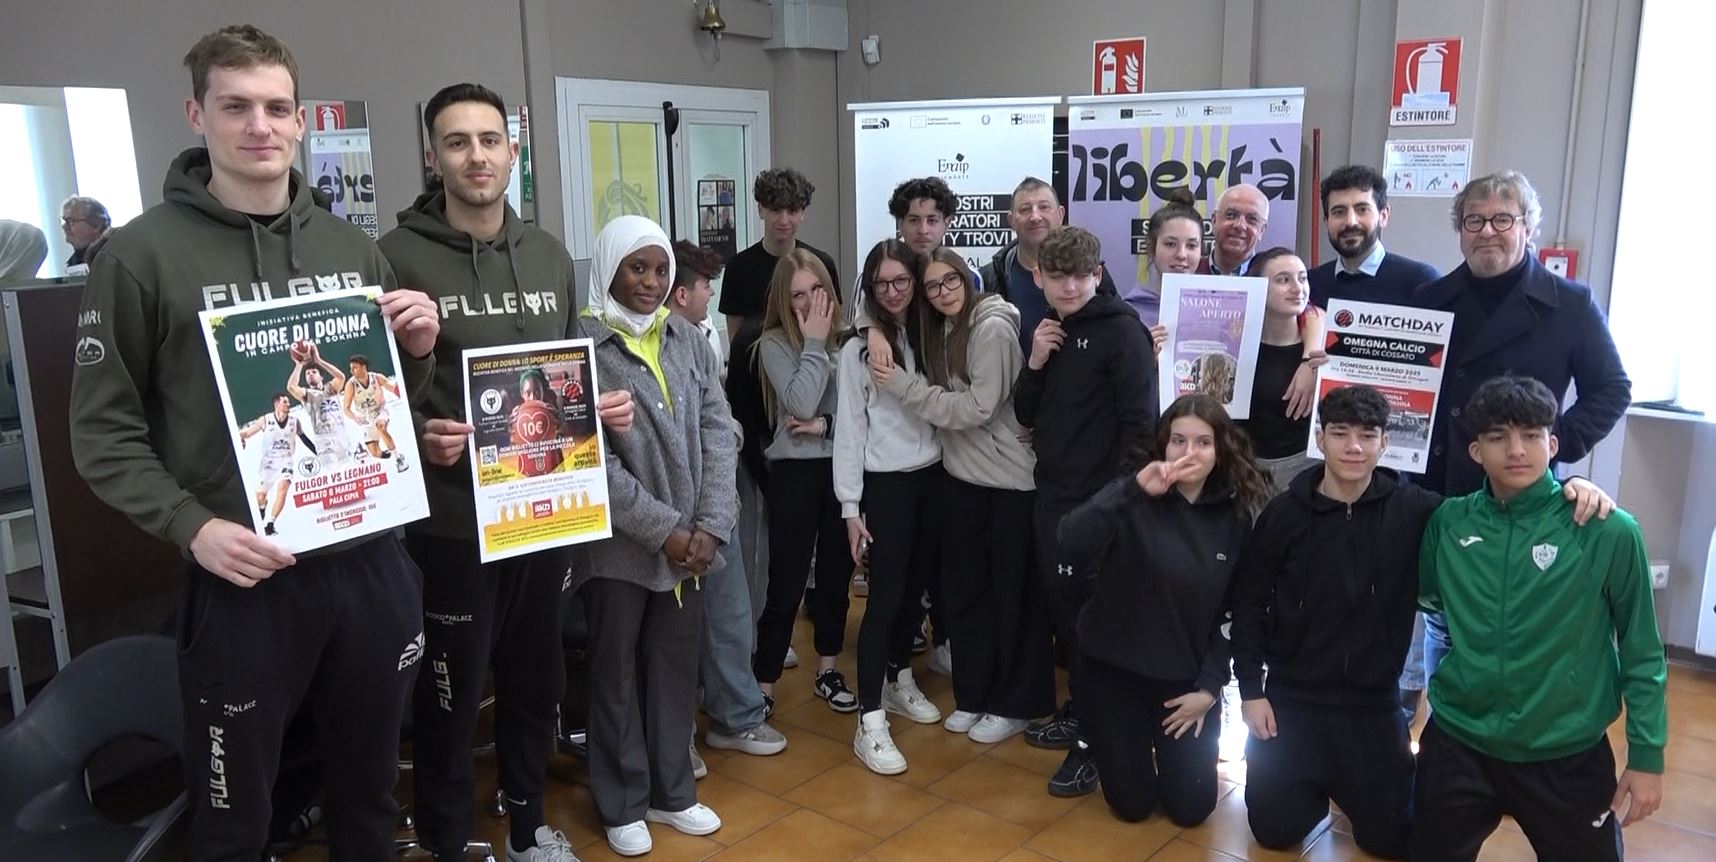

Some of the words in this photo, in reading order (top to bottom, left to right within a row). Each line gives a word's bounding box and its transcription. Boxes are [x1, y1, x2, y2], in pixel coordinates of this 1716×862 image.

[1395, 110, 1450, 122] ESTINTORE
[1072, 138, 1296, 202] libertà
[956, 196, 994, 210] STRI
[948, 214, 1000, 228] RATORI
[964, 232, 1008, 245] TROVI
[258, 315, 300, 327] INIZIATIVA
[302, 308, 339, 319] BENEFICA
[1359, 313, 1444, 333] MATCHDAY
[234, 327, 288, 353] CUORE
[293, 323, 309, 341] DI
[314, 313, 370, 338] DONNA
[261, 343, 298, 355] CAMPO
[325, 331, 366, 343] SOKHNA
[1343, 336, 1387, 349] OMEGNA
[1389, 342, 1426, 353] CALCIO
[473, 362, 492, 370] CUORE
[530, 355, 549, 364] SPORT
[555, 351, 585, 360] SPERANZA
[1381, 350, 1415, 360] COSSATO
[1340, 362, 1374, 371] DOMENICA
[523, 421, 543, 437] 10€
[574, 452, 596, 460] questa
[295, 476, 328, 491] FULGOR
[331, 472, 342, 482] VS
[344, 463, 381, 480] LEGNANO
[302, 490, 327, 502] SABATO
[335, 482, 356, 494] MARZO
[329, 496, 343, 505] PALA
[433, 660, 452, 712] FULG
[228, 700, 256, 712] PALACE
